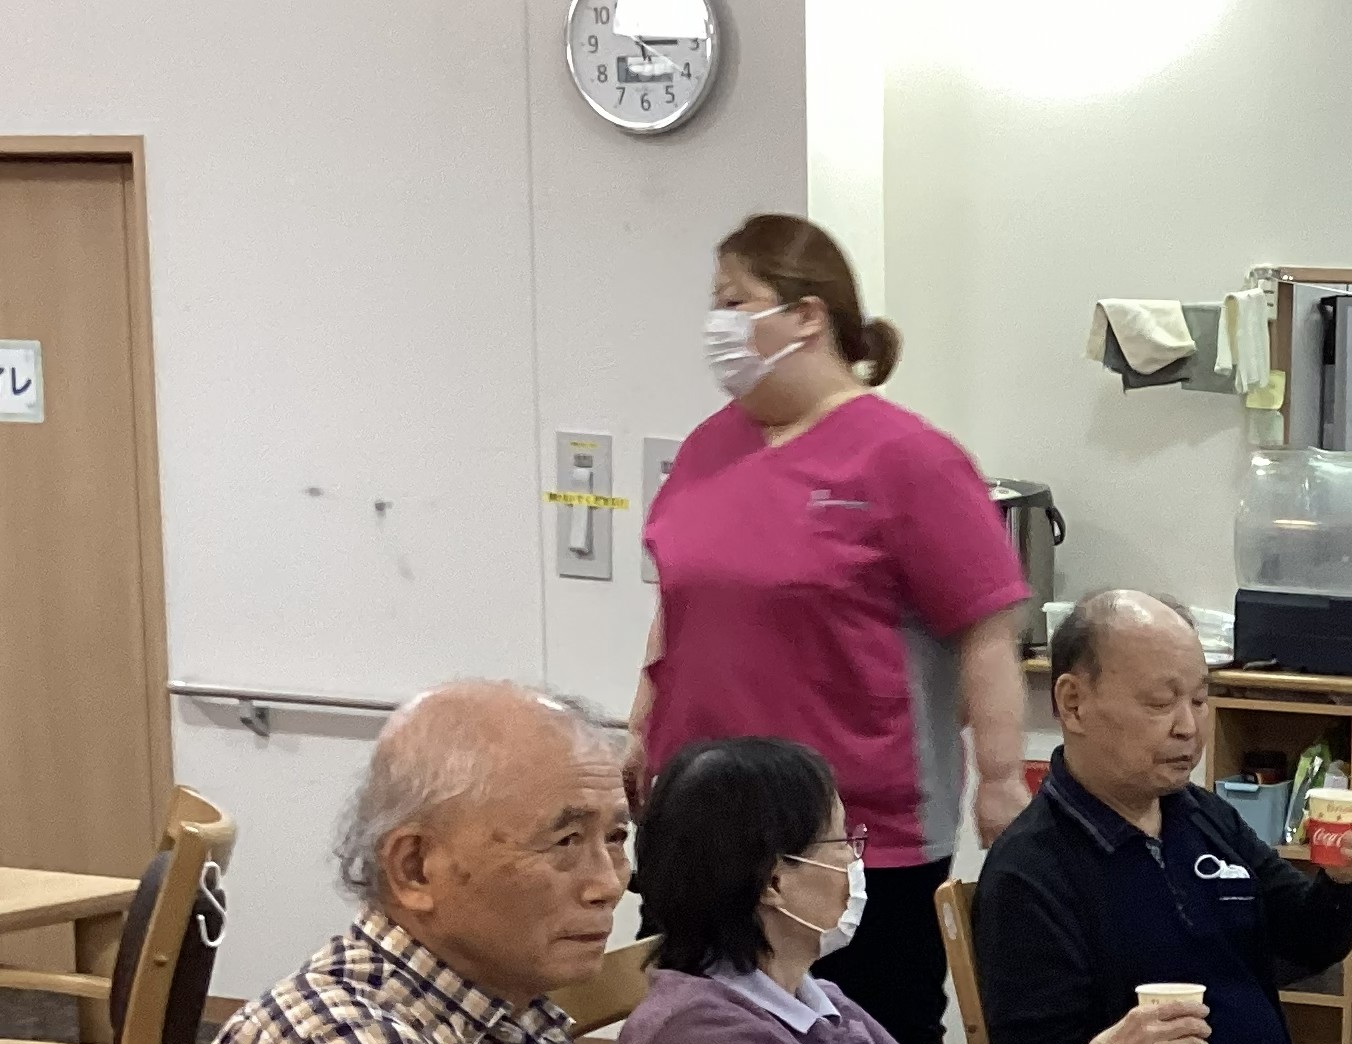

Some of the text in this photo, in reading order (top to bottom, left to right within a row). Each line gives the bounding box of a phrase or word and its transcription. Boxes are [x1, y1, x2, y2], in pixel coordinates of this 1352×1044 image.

[593, 6, 610, 25] 10
[588, 35, 598, 53] 9
[597, 64, 608, 83] 8
[680, 62, 692, 80] 4
[616, 86, 626, 105] 7
[640, 92, 651, 112] 6
[665, 85, 675, 104] 5
[0, 366, 32, 395] レ
